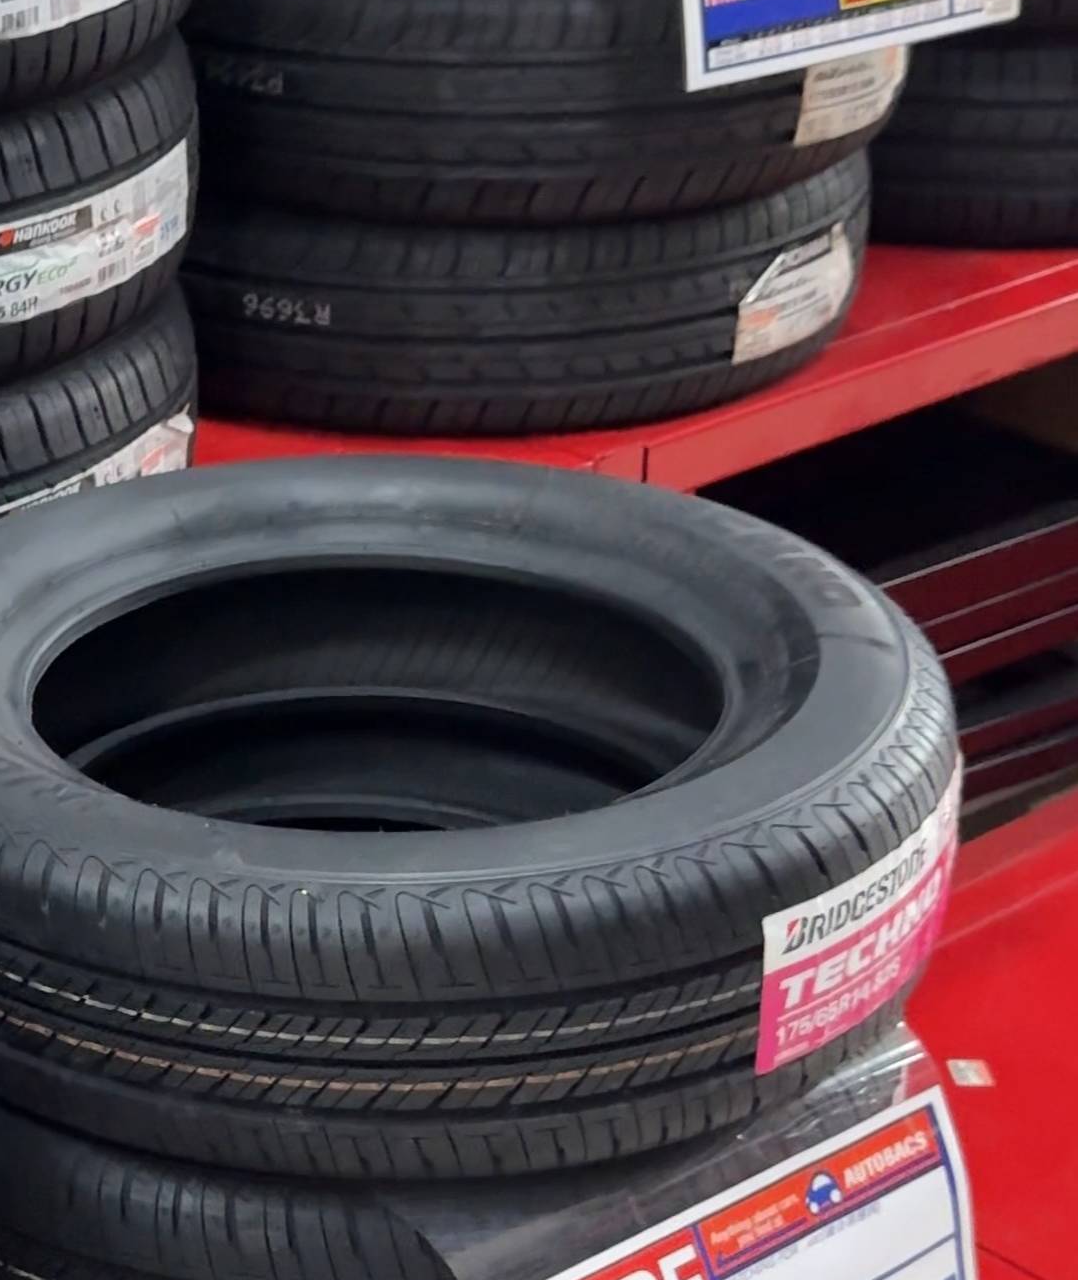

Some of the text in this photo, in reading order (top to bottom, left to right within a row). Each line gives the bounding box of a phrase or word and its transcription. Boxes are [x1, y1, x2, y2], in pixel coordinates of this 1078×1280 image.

[779, 867, 942, 1010] TECHNO
[782, 837, 927, 955] BRIDGESTONE
[843, 1130, 929, 1188] AUTOBACS
